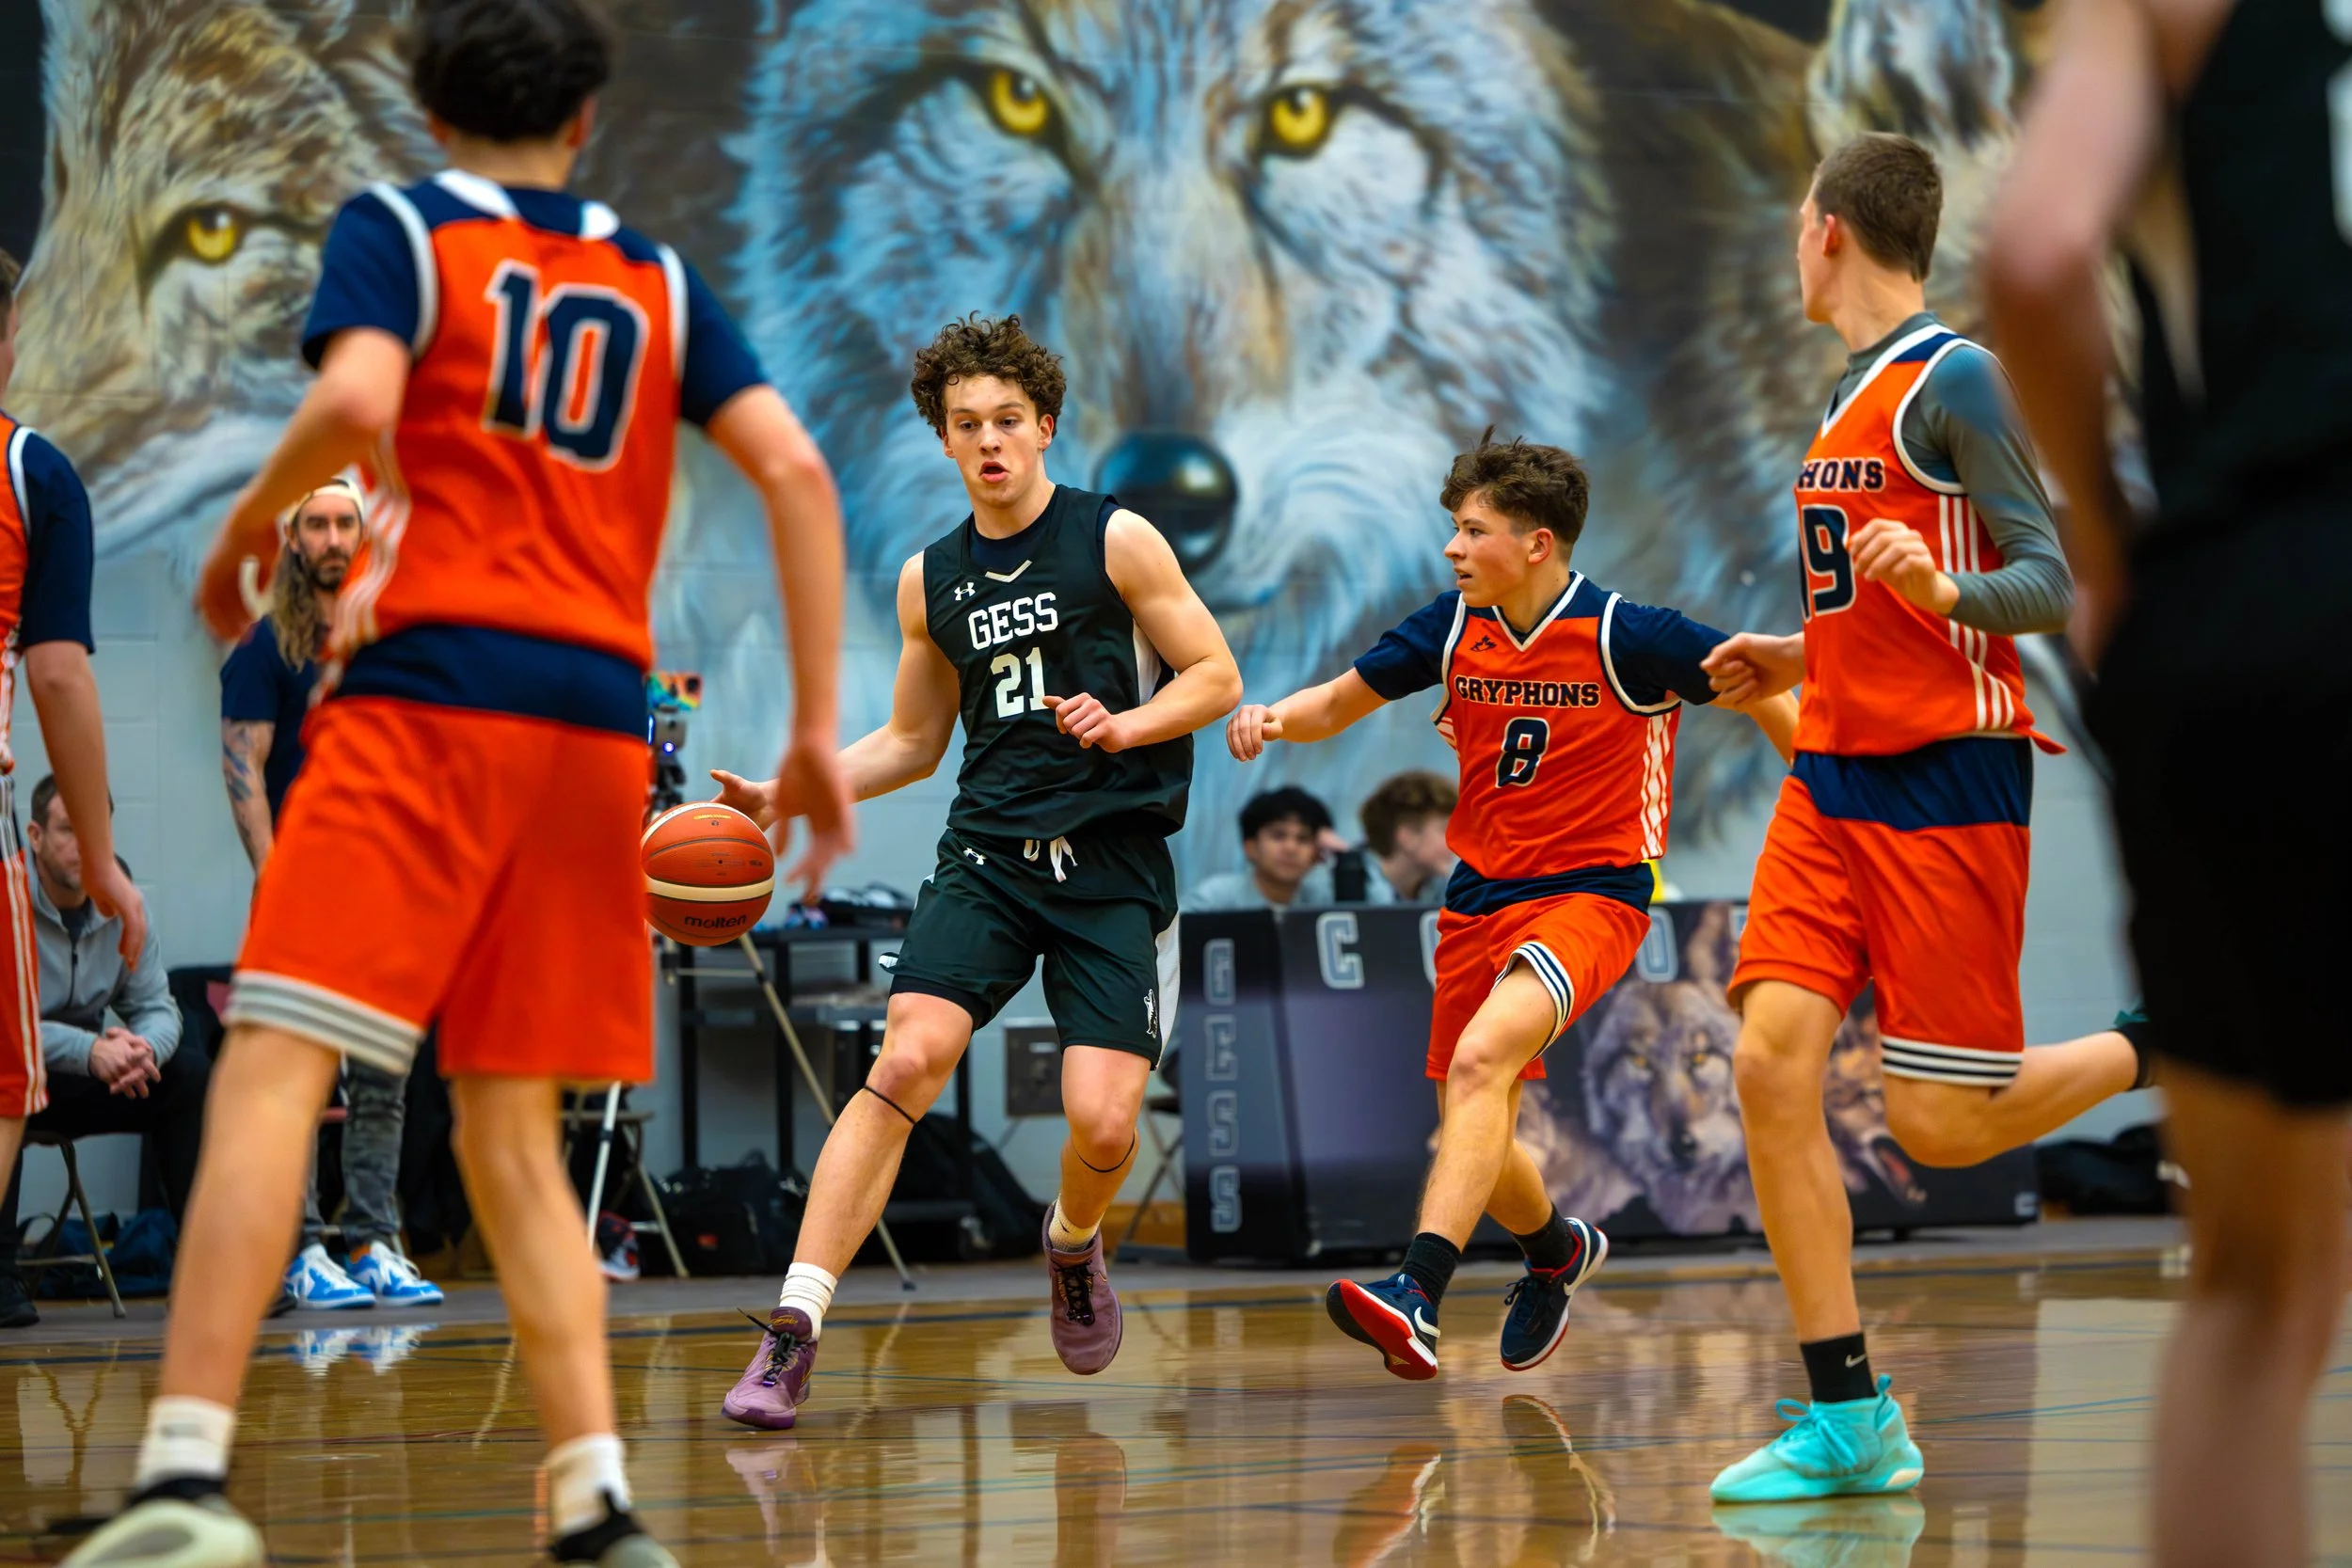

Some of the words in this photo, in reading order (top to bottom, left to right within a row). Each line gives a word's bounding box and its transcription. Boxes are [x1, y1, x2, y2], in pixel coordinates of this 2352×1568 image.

[481, 258, 650, 473] 10
[968, 592, 1058, 650] GESS
[990, 647, 1049, 719] 21
[1454, 674, 1601, 708] GRYPHONS
[1495, 716, 1550, 788] 8
[684, 914, 747, 928] molten
[1203, 939, 1243, 1234] GESS
